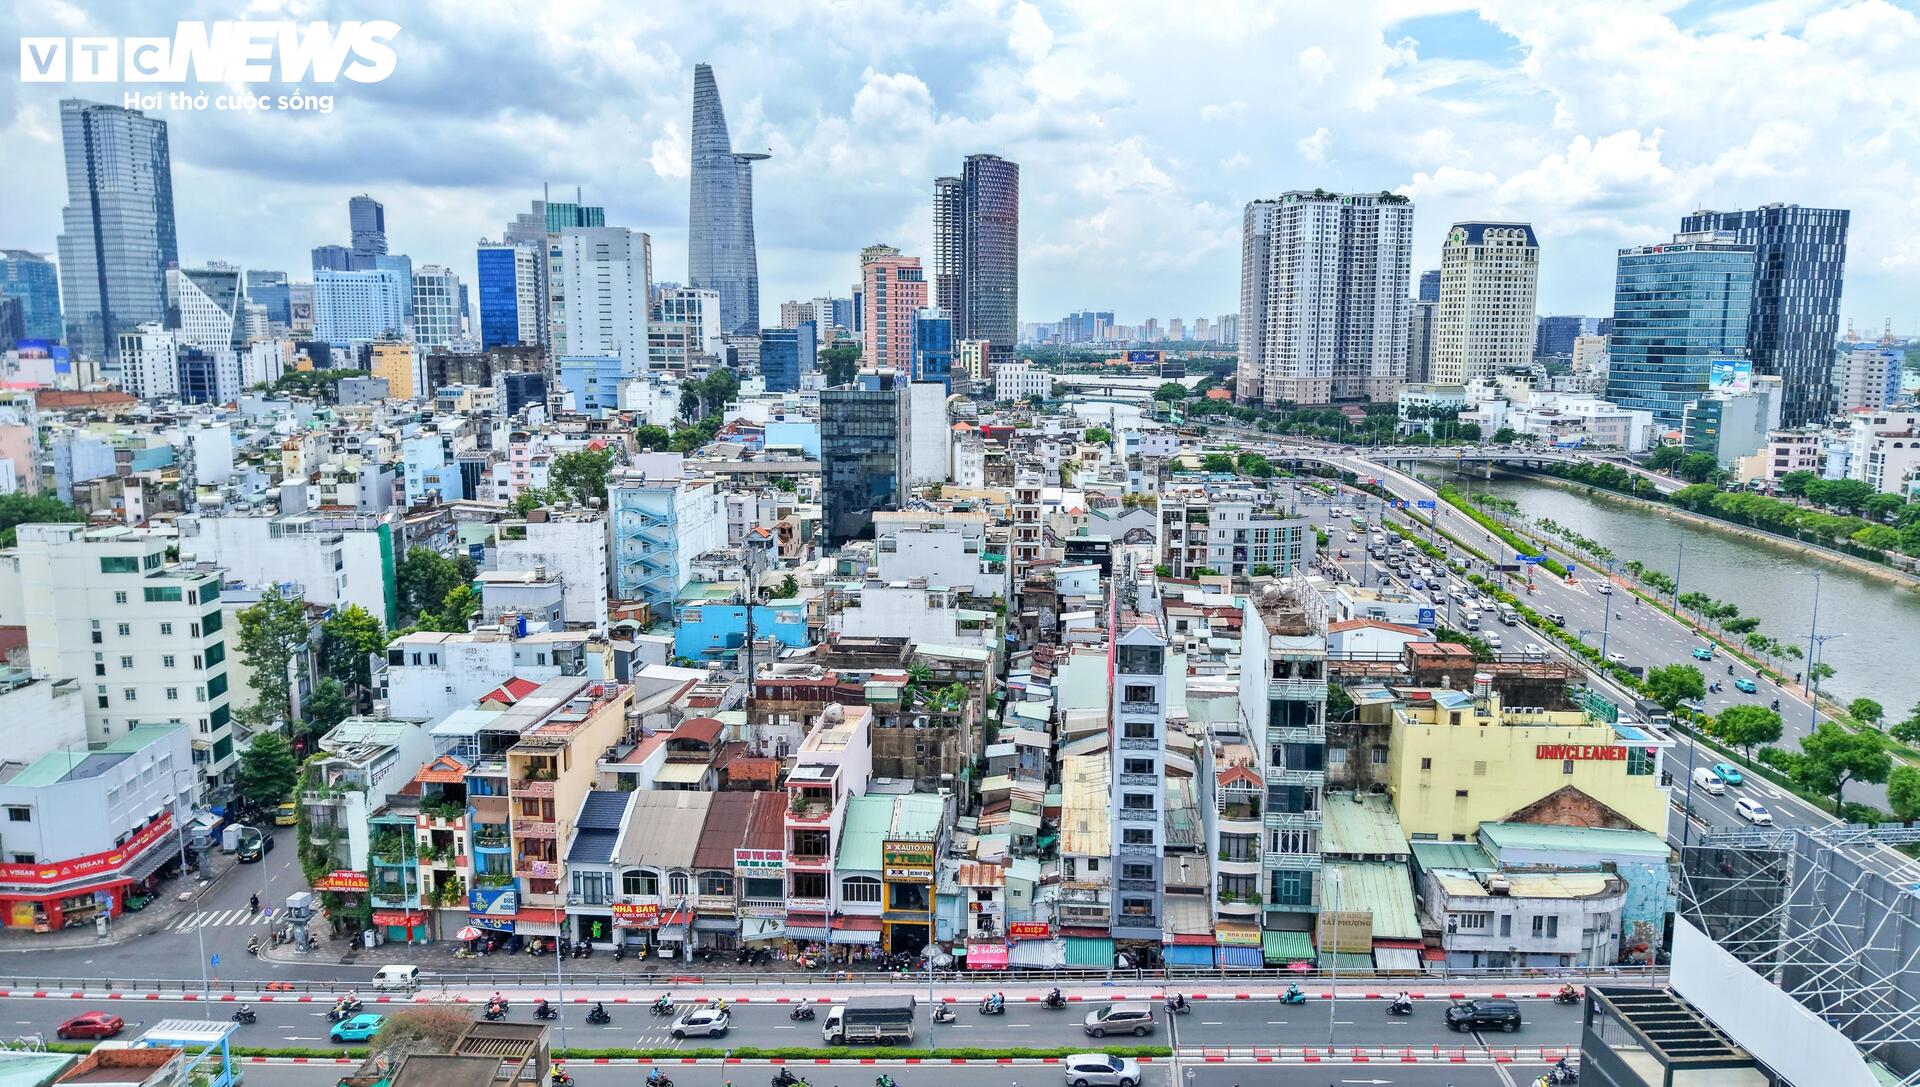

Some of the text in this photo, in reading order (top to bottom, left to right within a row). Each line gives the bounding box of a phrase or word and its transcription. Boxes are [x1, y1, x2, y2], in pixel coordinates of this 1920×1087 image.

[1653, 245, 1663, 253] FE
[1664, 243, 1695, 252] CREDIT
[73, 859, 105, 871] VISSAN
[9, 869, 36, 877] VISSAN
[471, 902, 489, 911] Tiger
